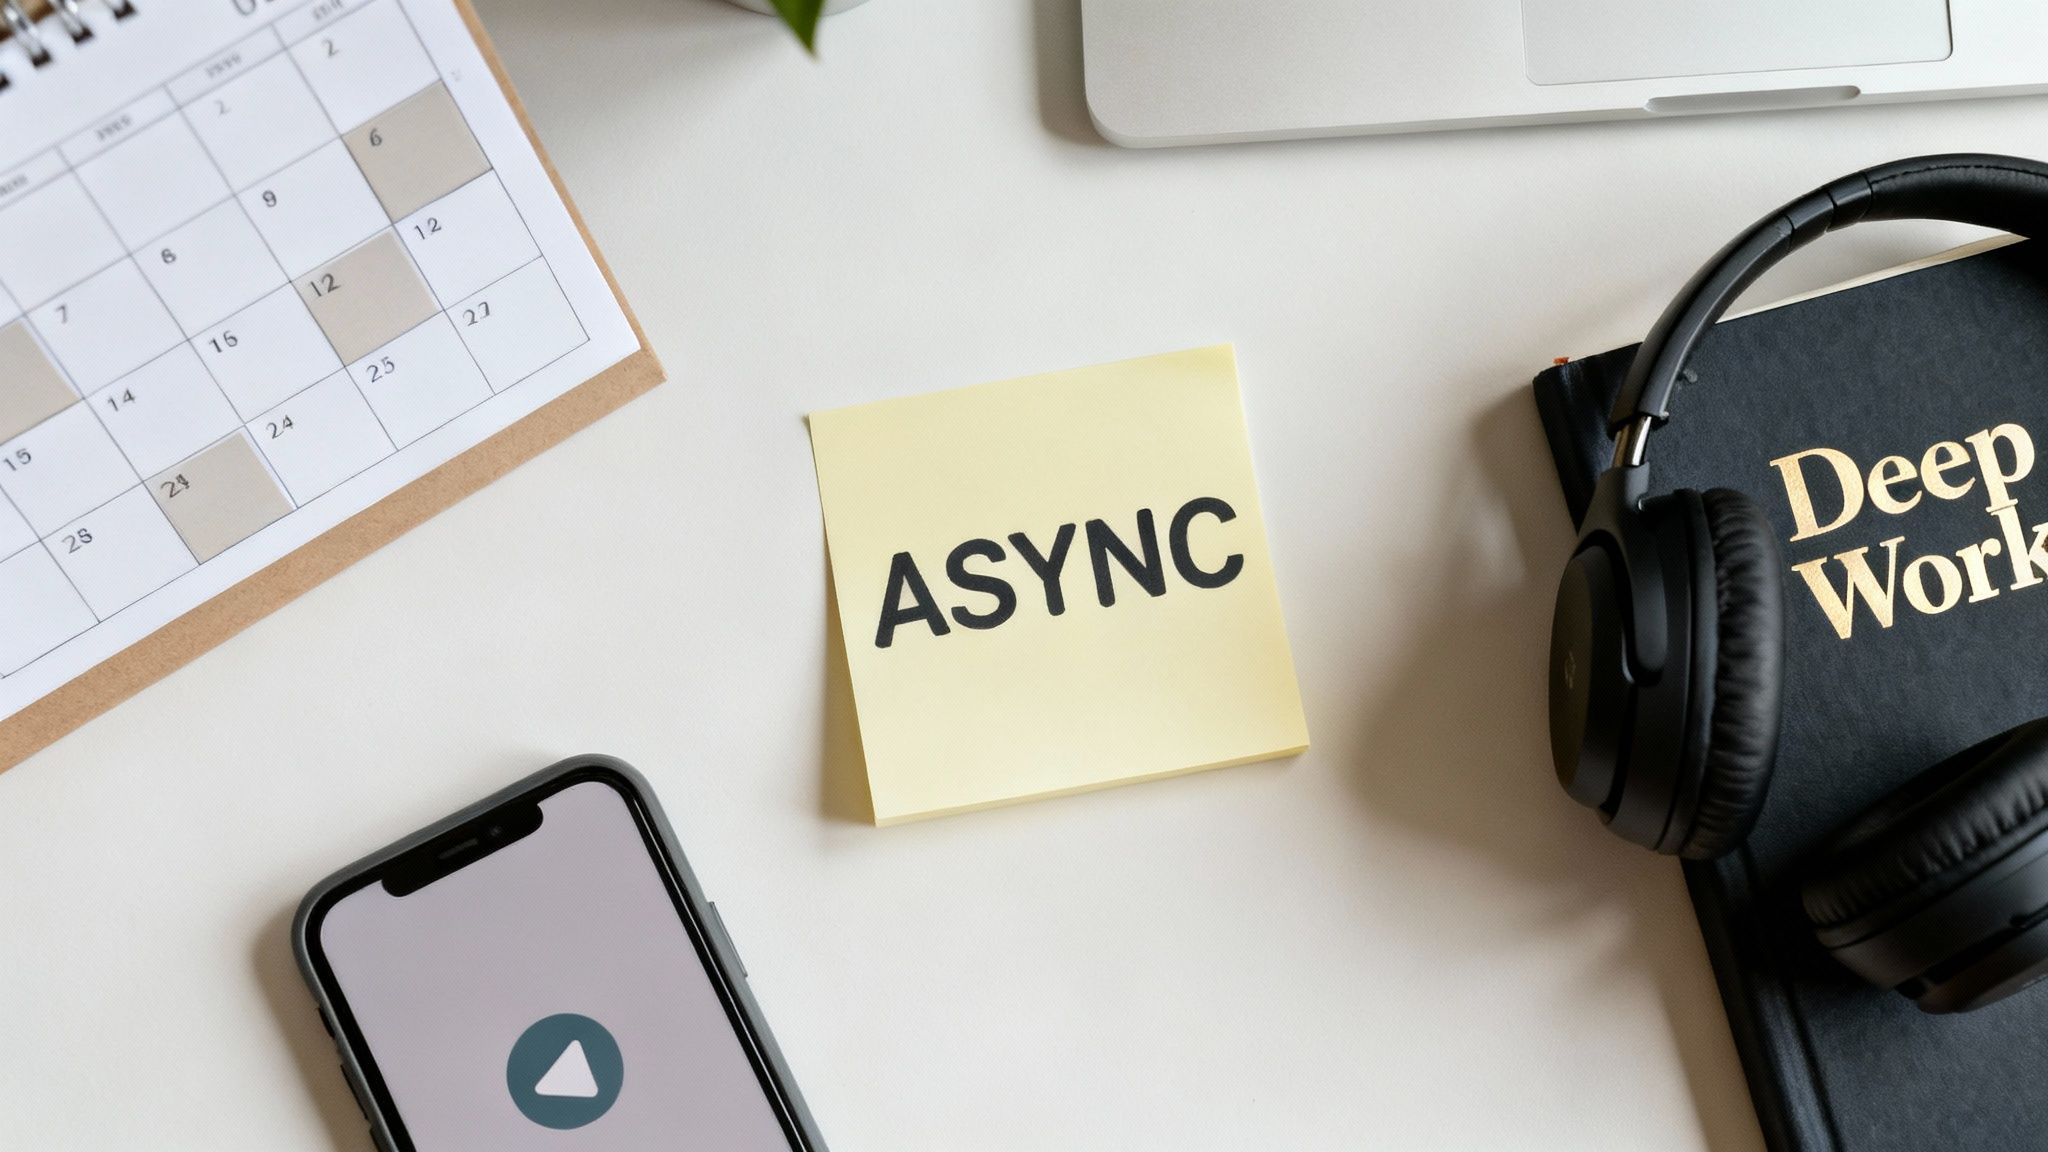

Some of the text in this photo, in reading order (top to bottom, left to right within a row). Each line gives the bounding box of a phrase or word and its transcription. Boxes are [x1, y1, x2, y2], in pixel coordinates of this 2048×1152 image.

[322, 38, 339, 58] 2
[368, 127, 383, 148] 6
[262, 189, 278, 208] 9
[413, 216, 443, 242] 12
[307, 273, 341, 298] 12
[54, 304, 69, 324] 7
[208, 329, 239, 354] 16
[366, 356, 396, 384] 25
[107, 388, 137, 413] 14
[266, 414, 295, 440] 24
[2, 447, 33, 473] 15
[1769, 423, 2035, 542] Deep
[875, 496, 1244, 649] ASYNC
[1791, 506, 2048, 640] Work
